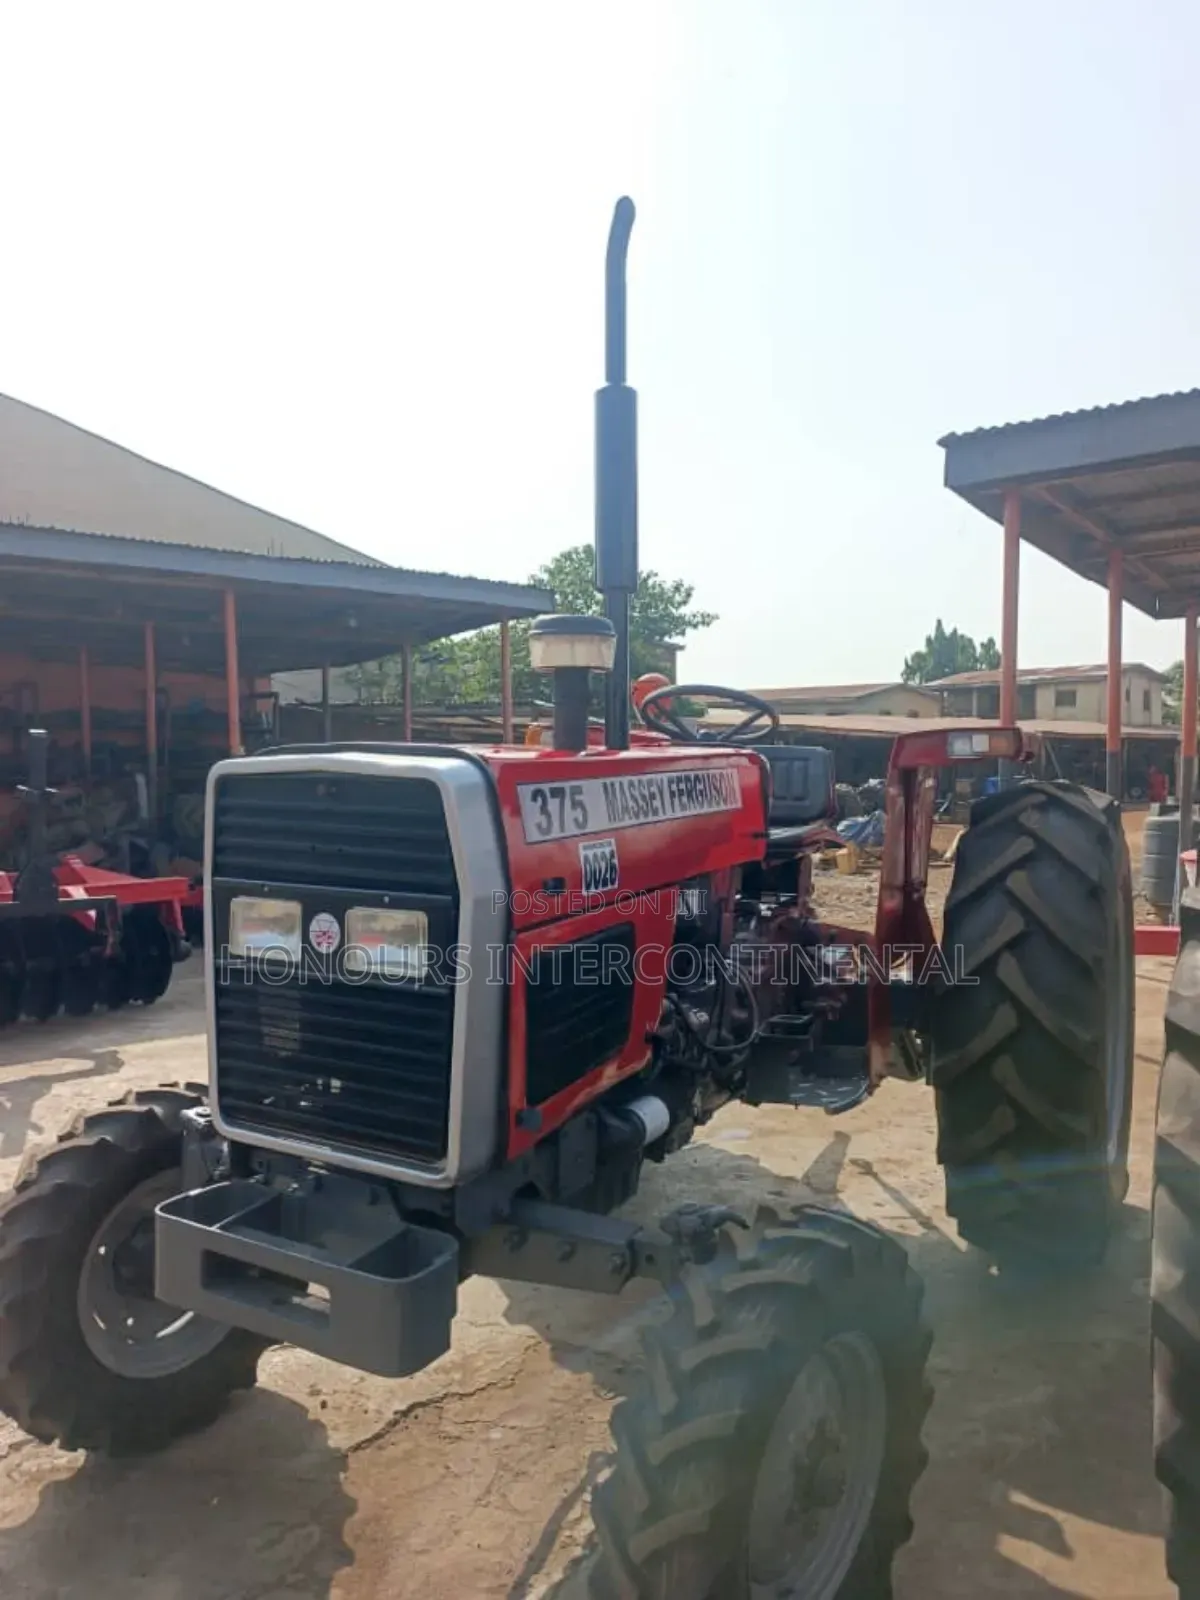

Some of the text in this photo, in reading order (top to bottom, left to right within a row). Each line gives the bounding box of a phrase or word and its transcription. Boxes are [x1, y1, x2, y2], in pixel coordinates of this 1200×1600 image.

[531, 771, 738, 836] 375 MASSEY FERGUSON
